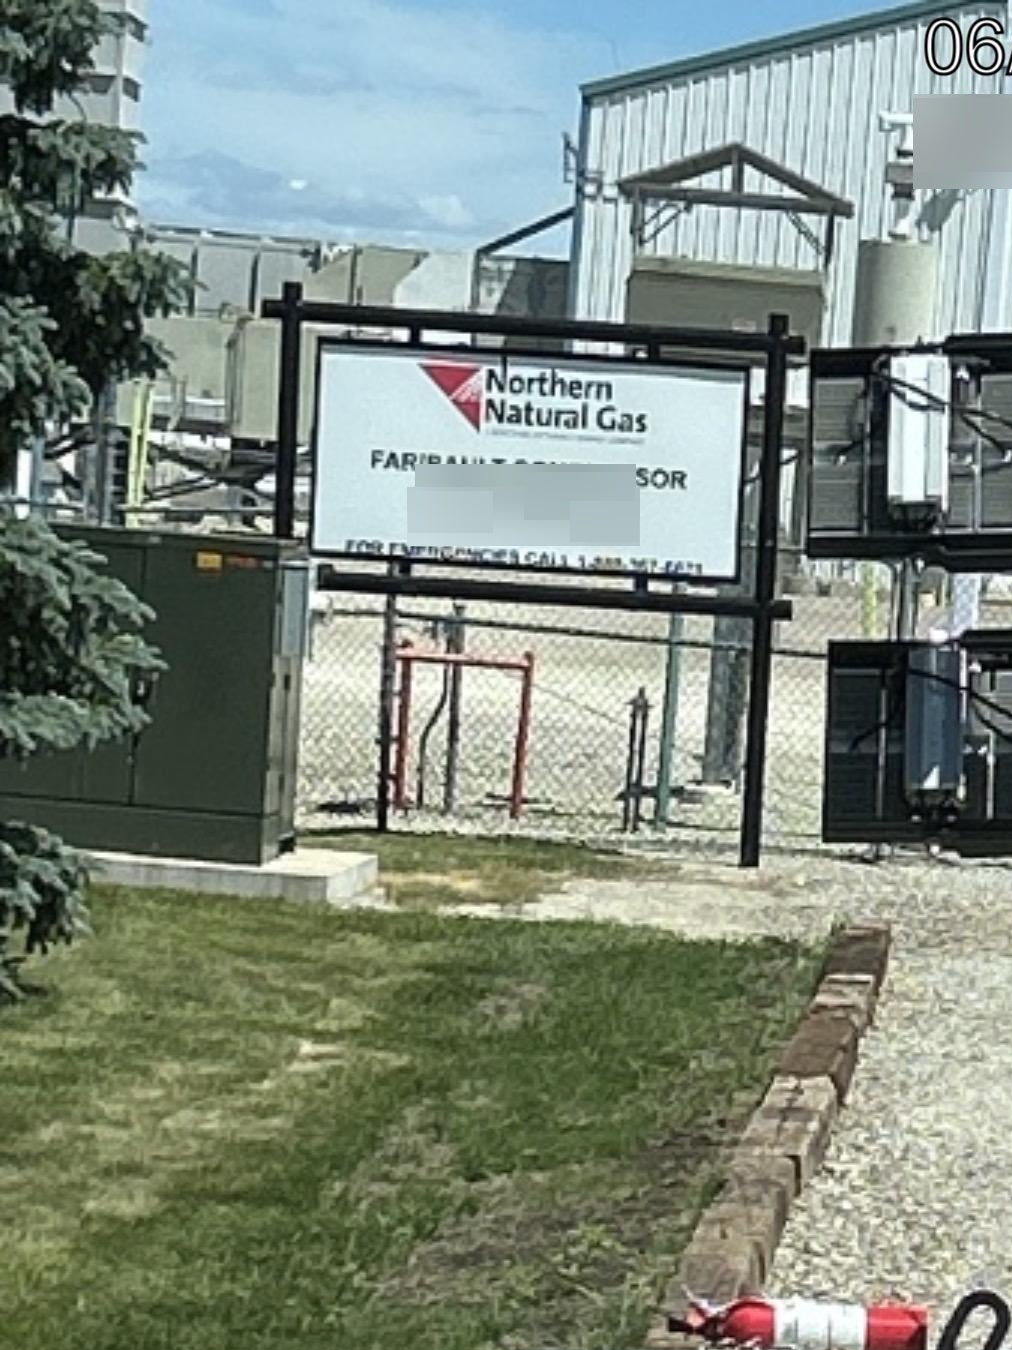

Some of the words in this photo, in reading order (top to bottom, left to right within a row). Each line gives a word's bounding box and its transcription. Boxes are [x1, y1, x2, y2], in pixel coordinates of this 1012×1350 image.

[485, 367, 612, 401] Northern
[485, 398, 588, 430] Natural
[596, 404, 648, 433] Gas
